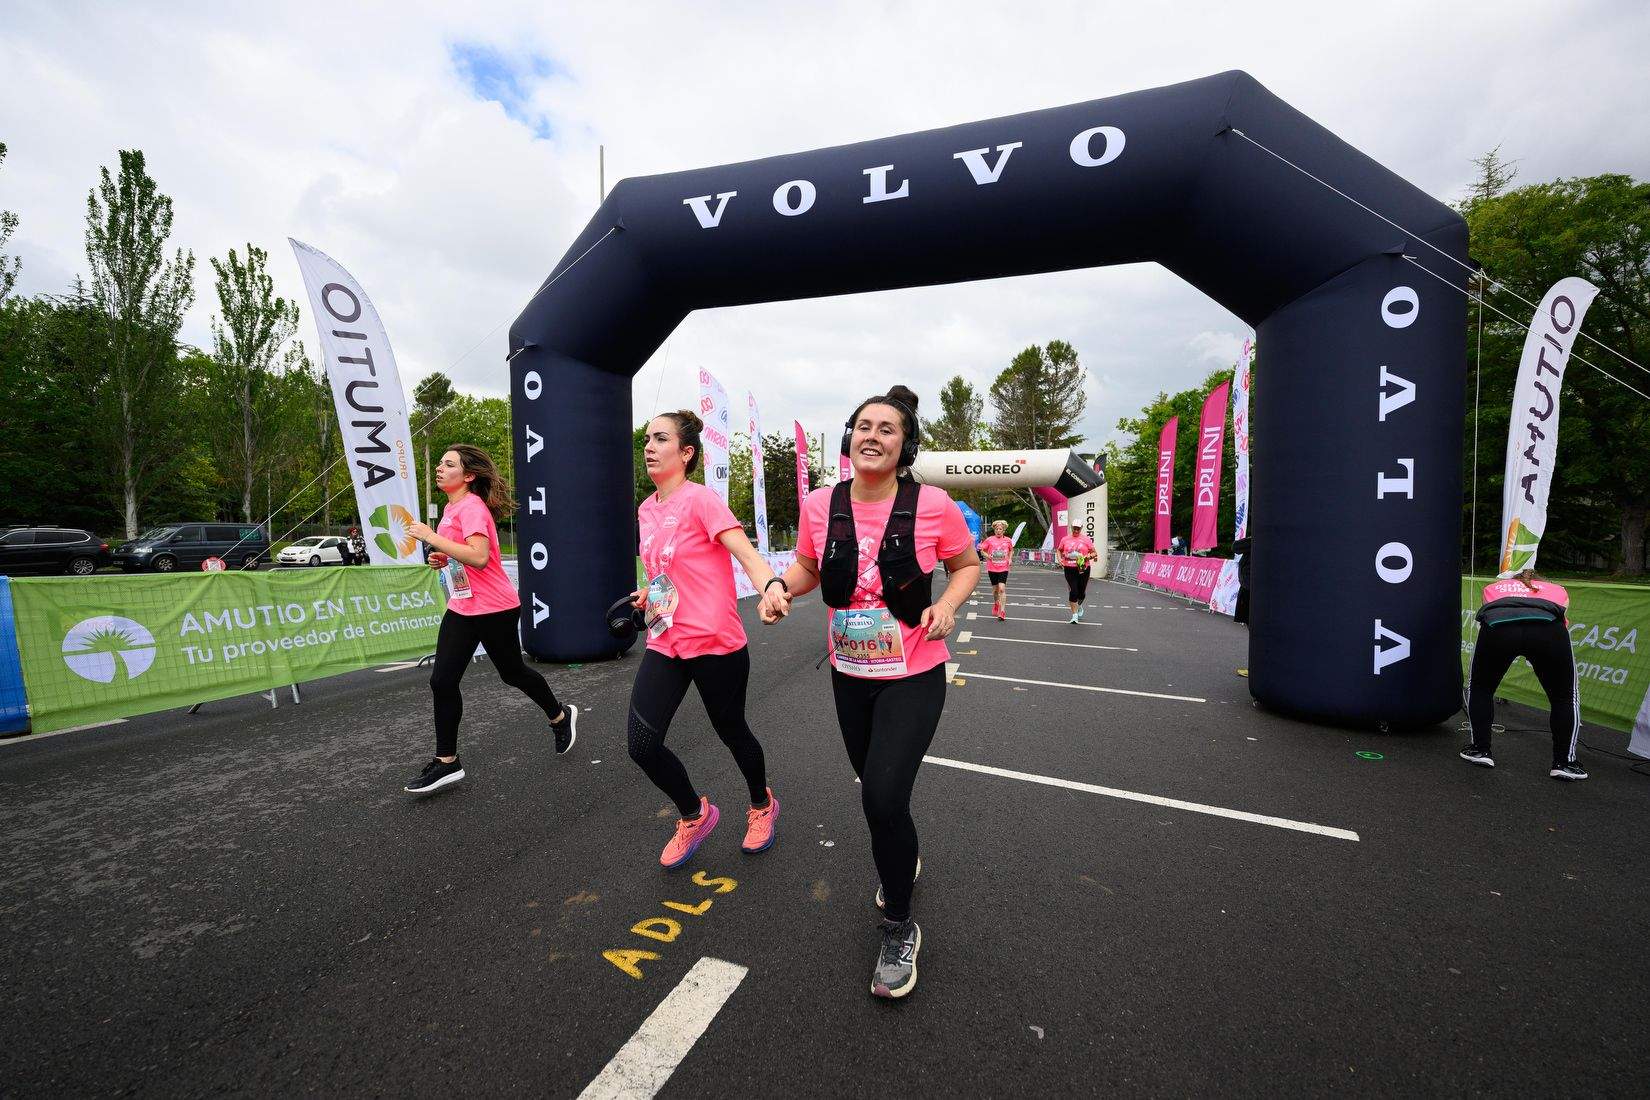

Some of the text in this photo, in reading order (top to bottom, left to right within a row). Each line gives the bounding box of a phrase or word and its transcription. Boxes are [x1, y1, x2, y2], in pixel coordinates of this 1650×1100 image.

[683, 126, 1126, 229] VOLVO
[524, 370, 551, 629] VOLVO
[945, 464, 1021, 474] EL CORREO
[1158, 450, 1172, 516] DRUNI
[1197, 426, 1221, 507] DRUNI
[1374, 286, 1420, 675] VOLVO
[1086, 502, 1095, 518] EL
[180, 590, 436, 637] AMUTIO EN TU CASA
[181, 614, 441, 664] Tu proveedor de Confianza
[1568, 623, 1637, 654] CASA
[602, 870, 738, 980] ADLS
